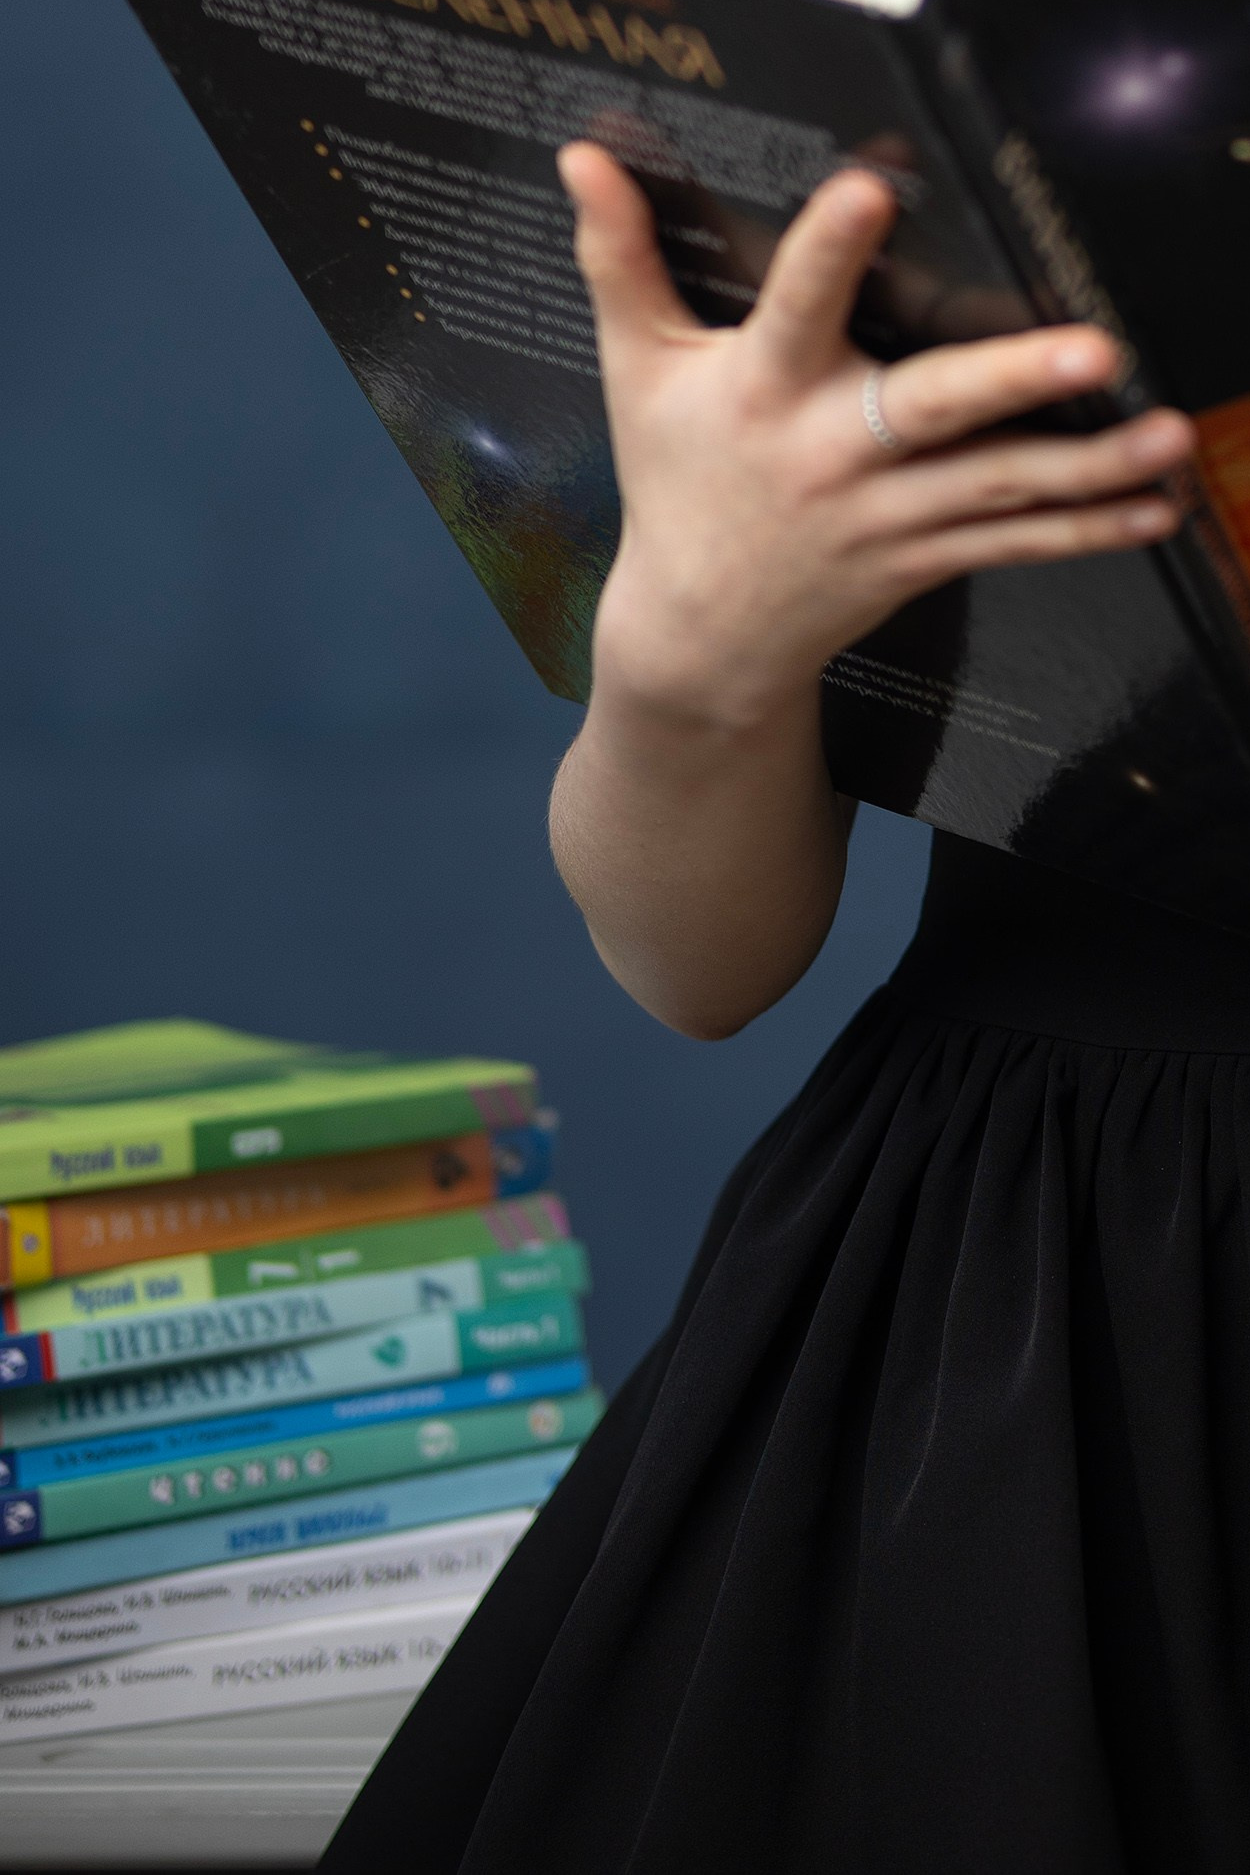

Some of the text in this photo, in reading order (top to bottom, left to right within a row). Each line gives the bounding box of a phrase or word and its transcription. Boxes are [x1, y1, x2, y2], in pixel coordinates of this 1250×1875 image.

[79, 1296, 334, 1369] ЛИТЕРАТУРА
[38, 1351, 313, 1427] ЛИТЕРАТУРА
[247, 1563, 359, 1604] РУССКИЙ
[211, 1645, 332, 1687] РУССКИЙ
